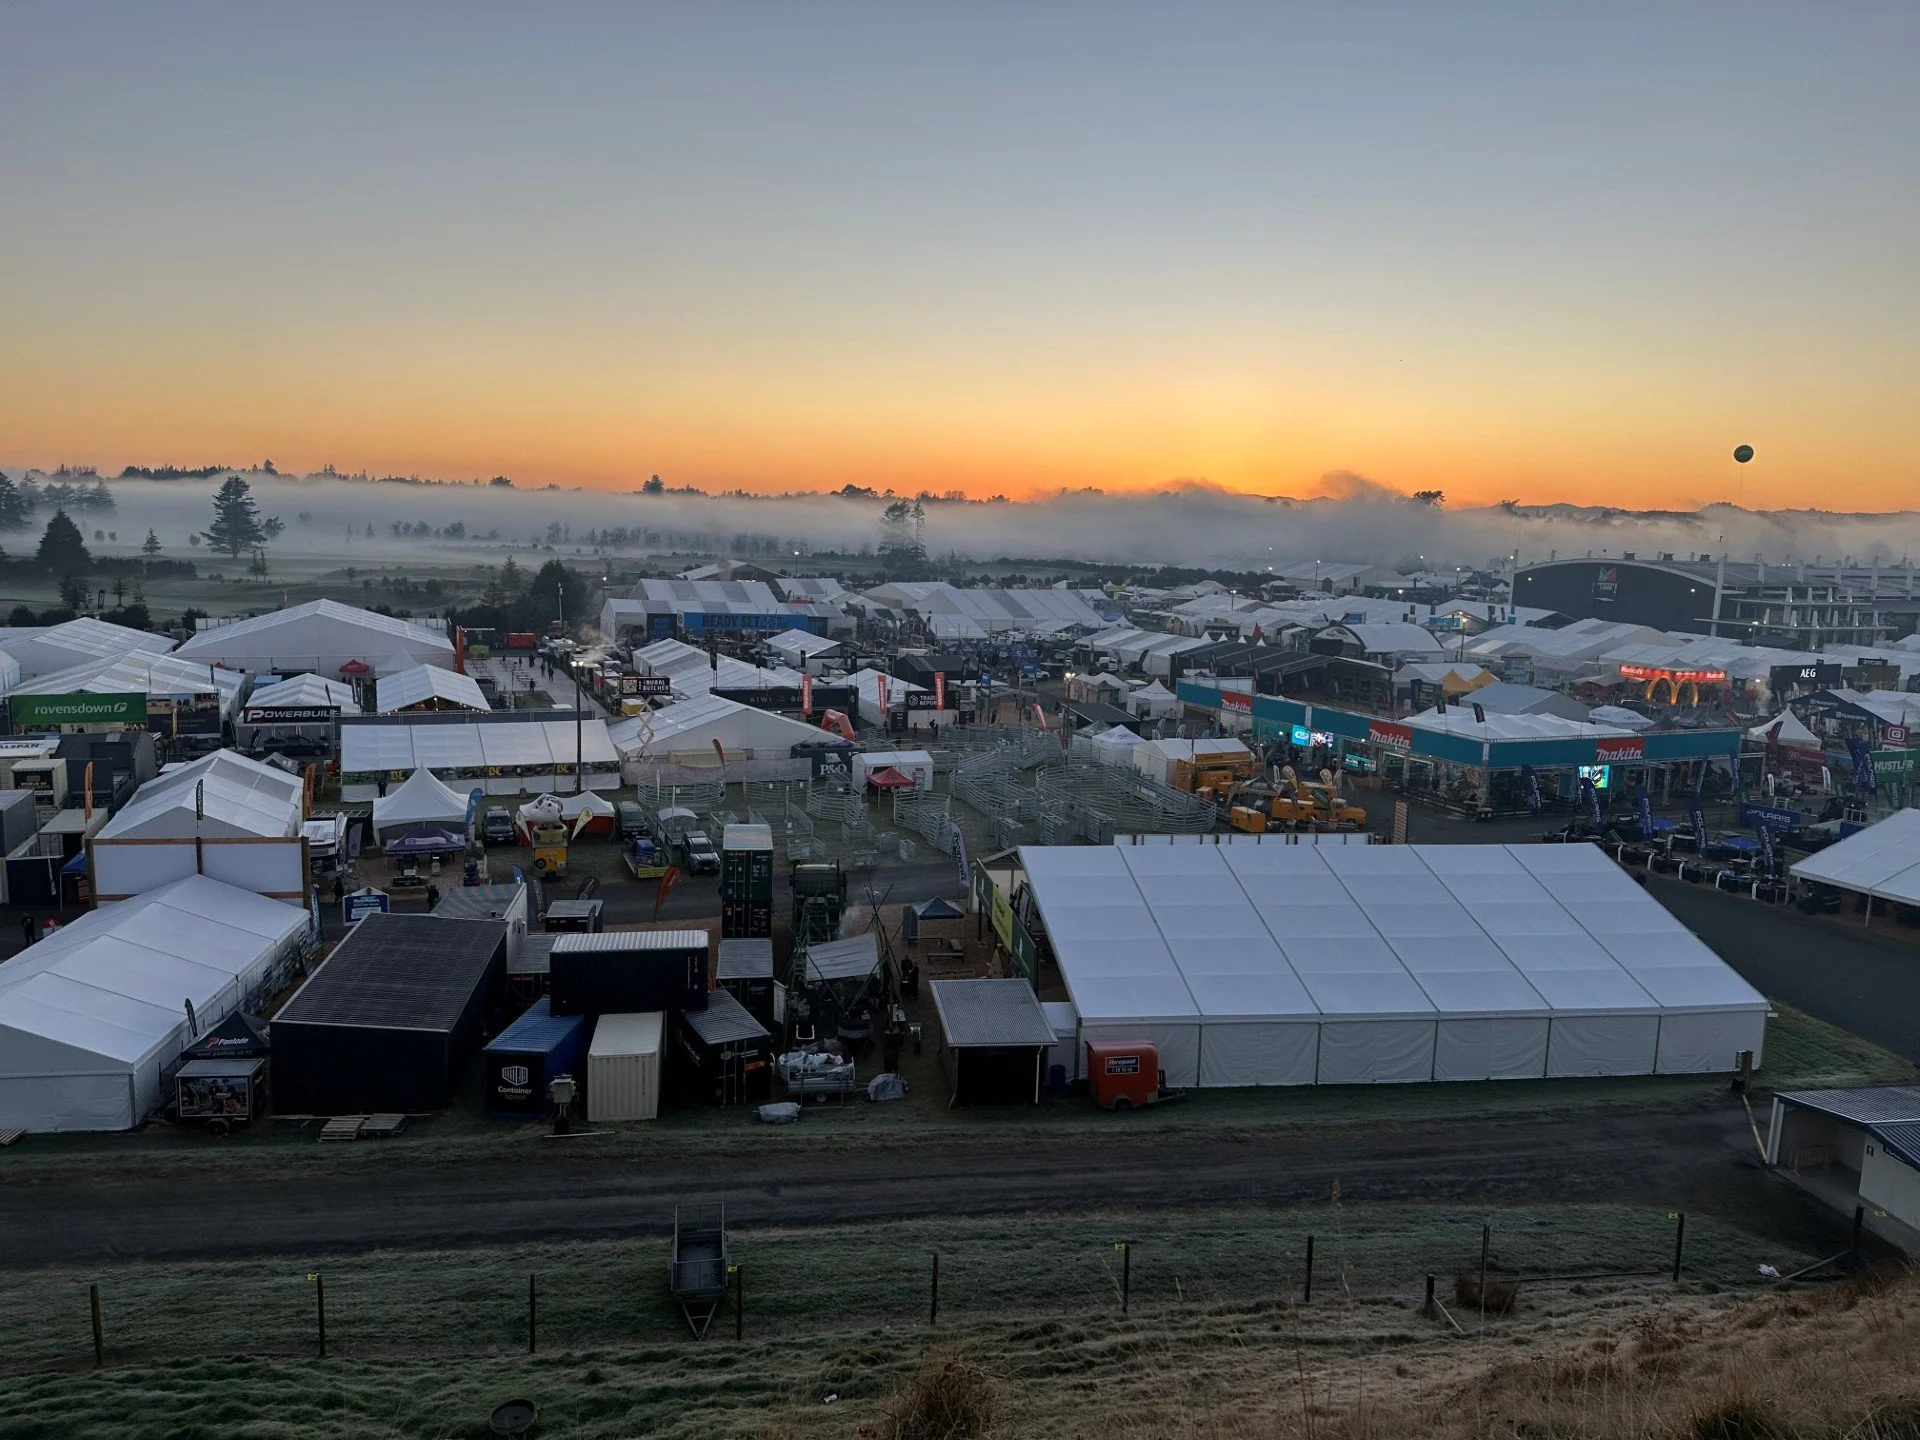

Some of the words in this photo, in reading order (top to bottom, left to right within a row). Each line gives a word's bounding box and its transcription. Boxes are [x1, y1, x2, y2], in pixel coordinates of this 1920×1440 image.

[703, 615, 738, 627] READY
[1800, 668, 1816, 678] AEG
[35, 703, 112, 715] ravensdown
[819, 763, 847, 775] P&O
[1590, 788, 1601, 823] POLARIS
[1746, 808, 1792, 824] POLARIS
[1695, 810, 1706, 849] POLARIS
[218, 1037, 250, 1046] Paslode
[497, 1086, 533, 1095] Container
